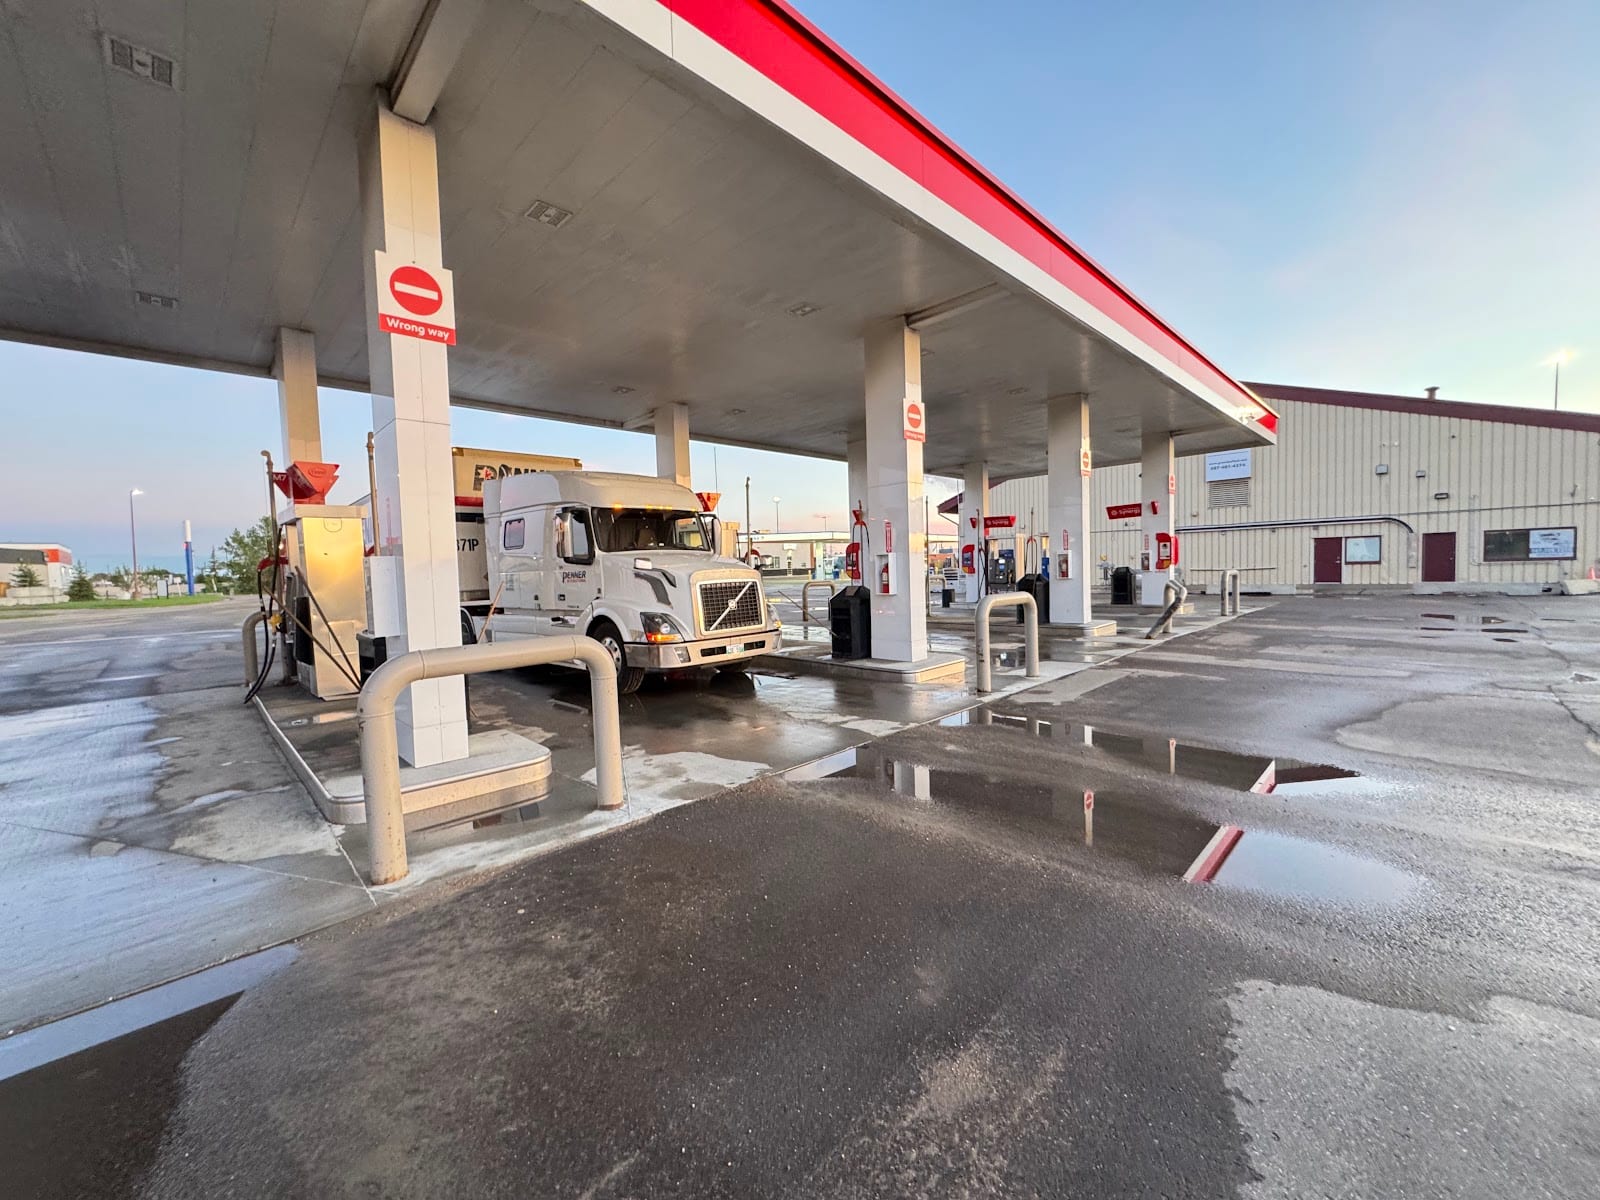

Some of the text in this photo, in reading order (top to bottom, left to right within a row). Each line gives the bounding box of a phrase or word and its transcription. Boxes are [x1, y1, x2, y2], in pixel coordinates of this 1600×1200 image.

[386, 317, 450, 341] Wrong way
[562, 570, 587, 584] PENNER
